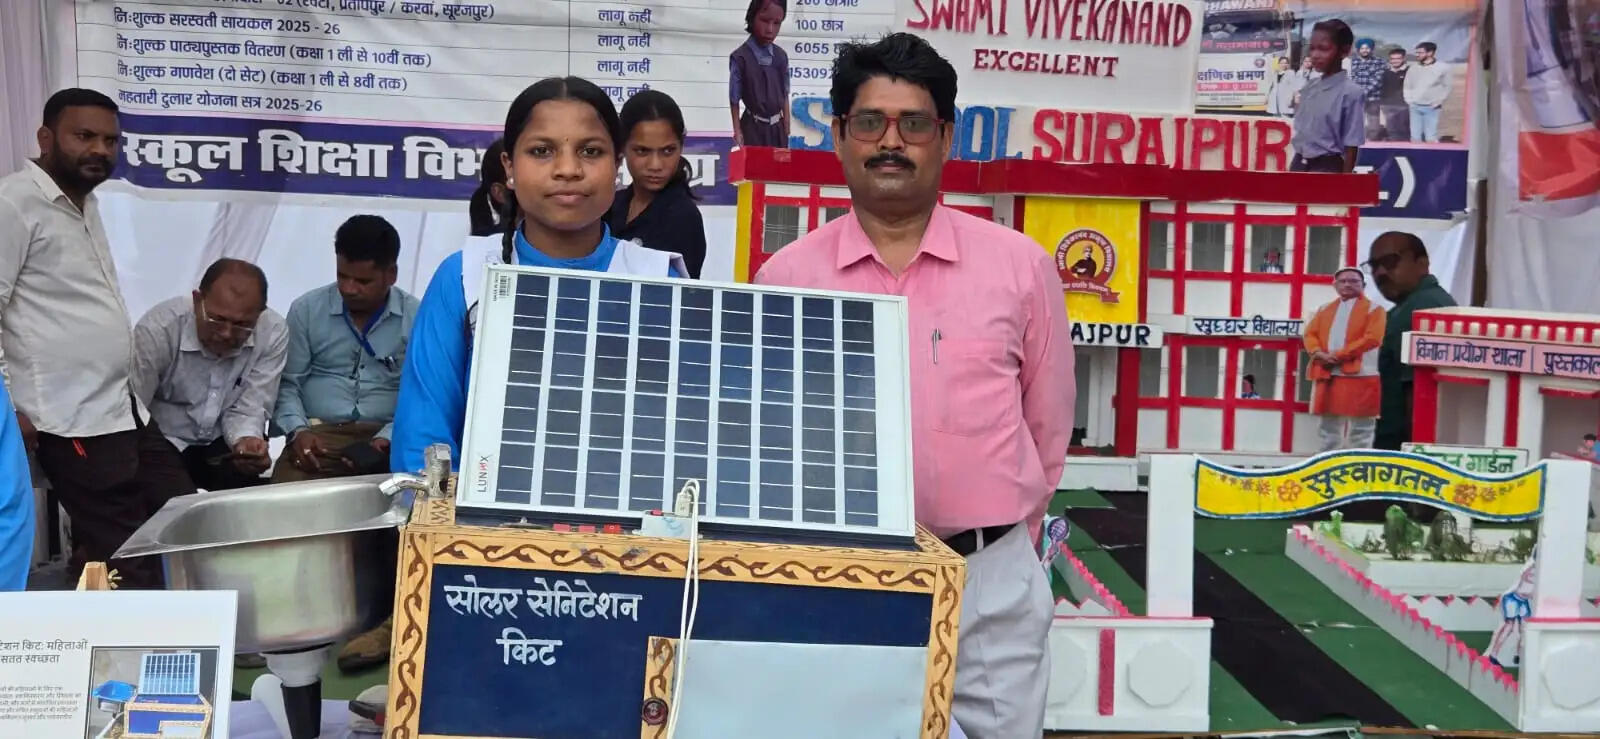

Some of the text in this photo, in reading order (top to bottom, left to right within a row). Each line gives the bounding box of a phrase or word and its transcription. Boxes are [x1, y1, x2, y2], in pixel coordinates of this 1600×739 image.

[169, 12, 217, 28] सरस्वती
[221, 16, 273, 30] सायकल
[277, 19, 310, 33] 2025
[324, 23, 341, 35] 26
[442, 4, 494, 21] सूरजपुर)
[597, 10, 626, 26] लागू
[906, 0, 1193, 47] SWAMI VIVEKANAND
[796, 20, 817, 31] 100
[170, 40, 241, 58] पाठ्यपुस्तक
[245, 40, 285, 58] वितरण
[290, 44, 323, 60] (कक्षा
[327, 49, 333, 61] 1
[338, 46, 352, 62] ली
[357, 47, 368, 62] से
[403, 53, 431, 68] तक)
[597, 35, 626, 51] लागू
[795, 42, 829, 54] 6055
[596, 60, 625, 77] लागू
[973, 49, 1119, 77] EXCELLENT
[170, 63, 214, 80] गणवेश
[219, 65, 236, 82] (दो
[240, 66, 266, 84] सेट)
[271, 71, 305, 86] (कक्षा
[310, 74, 315, 85] 1
[320, 71, 334, 87] ली
[338, 72, 349, 87] से
[379, 77, 407, 92] तक)
[161, 92, 192, 109] दुलार
[197, 90, 237, 107] योजना
[241, 96, 261, 110] सत्र
[265, 97, 322, 111] 2025-26
[1032, 107, 1294, 171] SURAJPUR
[121, 128, 483, 183] स्कूल शिक्षा विभ
[1071, 322, 1150, 345] AJPUR
[1452, 341, 1489, 363] प्रयोग
[1492, 347, 1526, 368] शाला
[1543, 351, 1600, 376] पुस्तकाल
[444, 574, 642, 622] सोलर सेनिटेशन
[496, 627, 563, 666] किट
